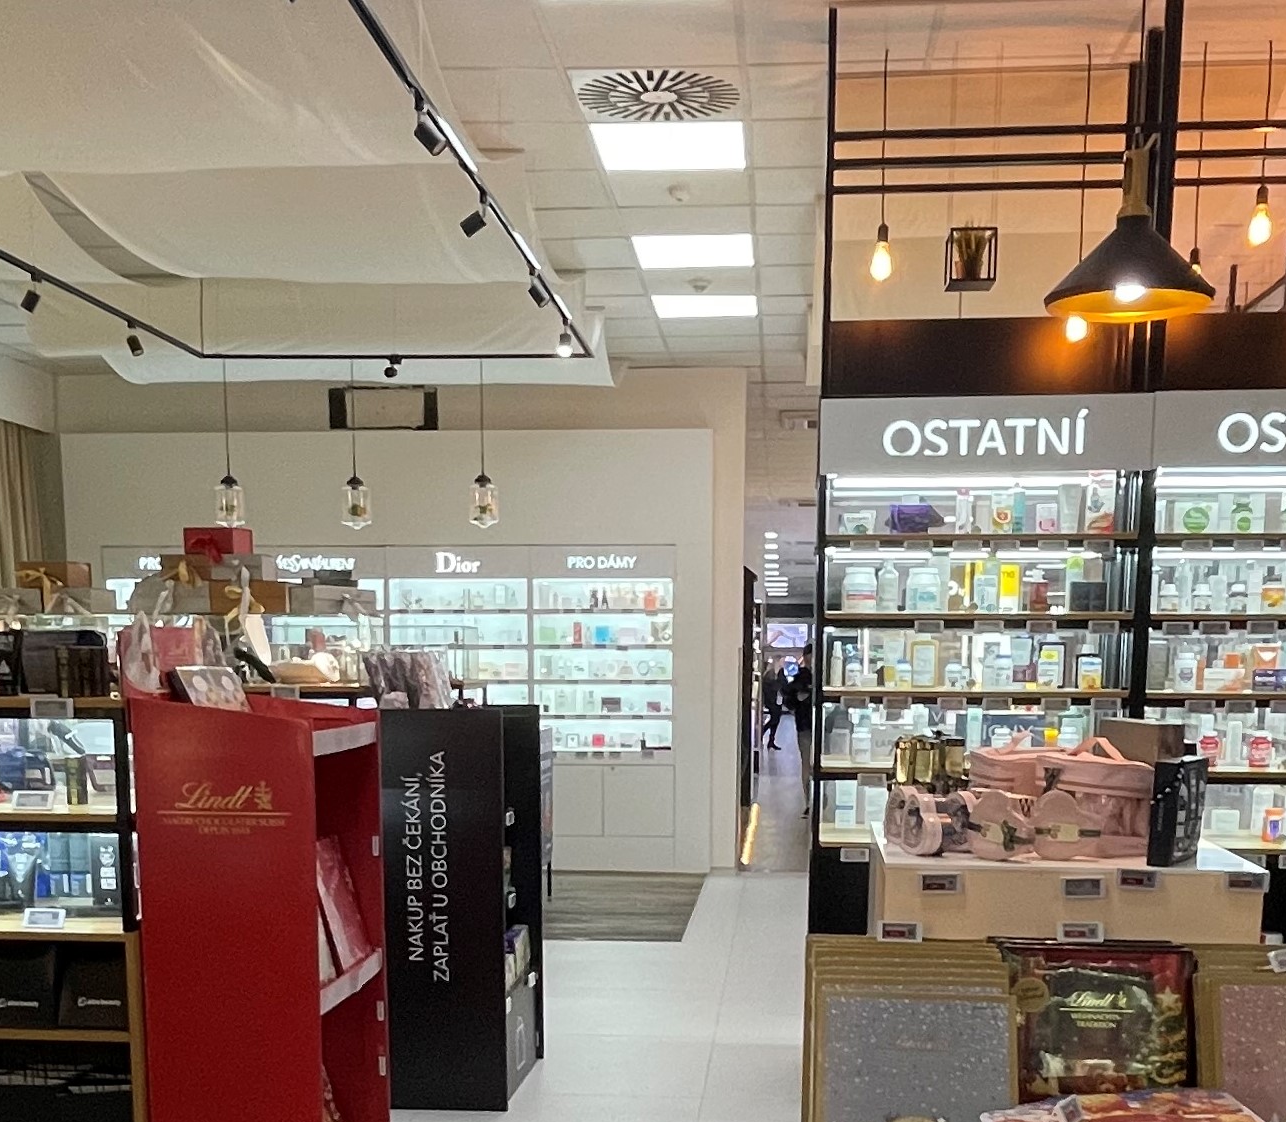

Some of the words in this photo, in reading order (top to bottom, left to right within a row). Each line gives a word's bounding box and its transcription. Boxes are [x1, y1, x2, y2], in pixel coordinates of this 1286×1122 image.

[882, 408, 1089, 456] OSTATNÍ
[435, 551, 481, 573] Dior
[567, 555, 595, 570] PRO
[597, 553, 637, 570] DÁMY
[175, 781, 253, 810] Lindt
[400, 773, 423, 850] ČEKÁNÍ,
[425, 751, 449, 888] OBCHODNÍKA
[406, 855, 423, 889] BEZ
[432, 894, 449, 907] U
[407, 895, 424, 961] NAKUP
[429, 912, 449, 982] ZAPLAŤ
